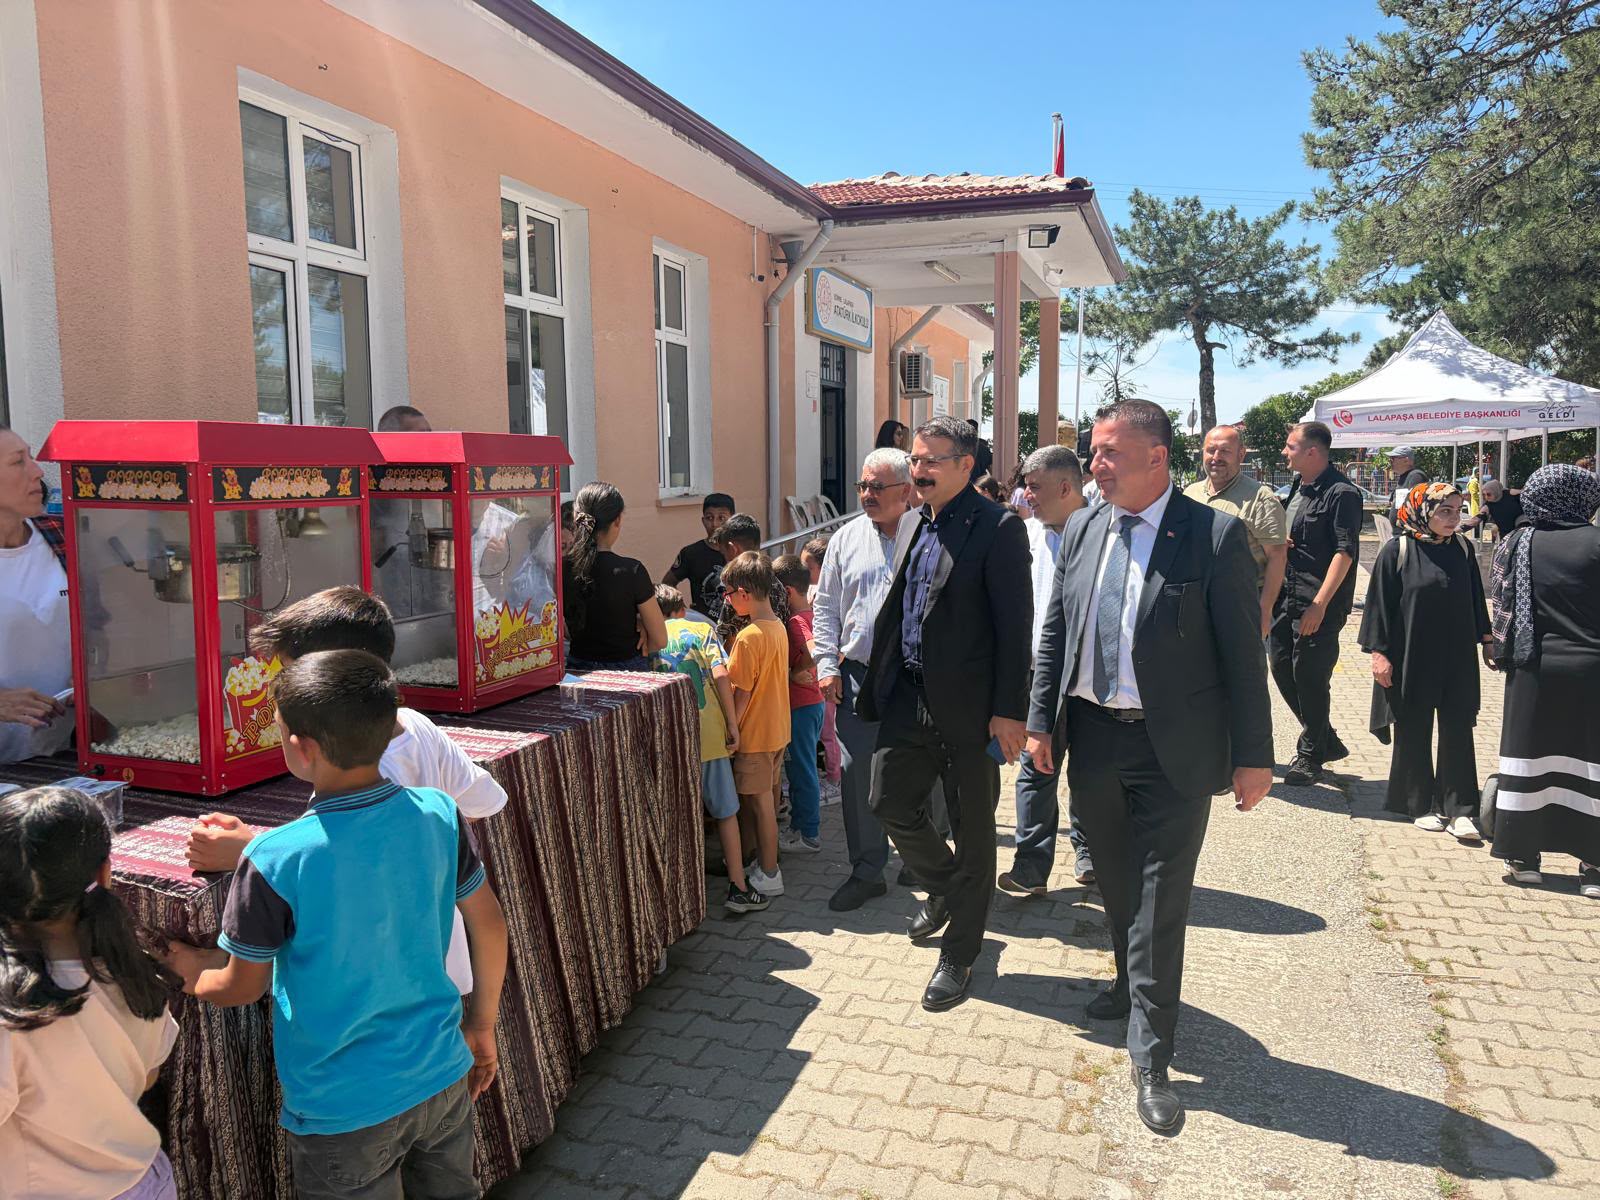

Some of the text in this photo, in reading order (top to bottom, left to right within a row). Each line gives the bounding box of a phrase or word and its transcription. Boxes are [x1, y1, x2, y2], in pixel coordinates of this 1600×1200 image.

[1367, 409, 1521, 422] LALAPAŞA BELEDİYE BAŞKANLIĞI
